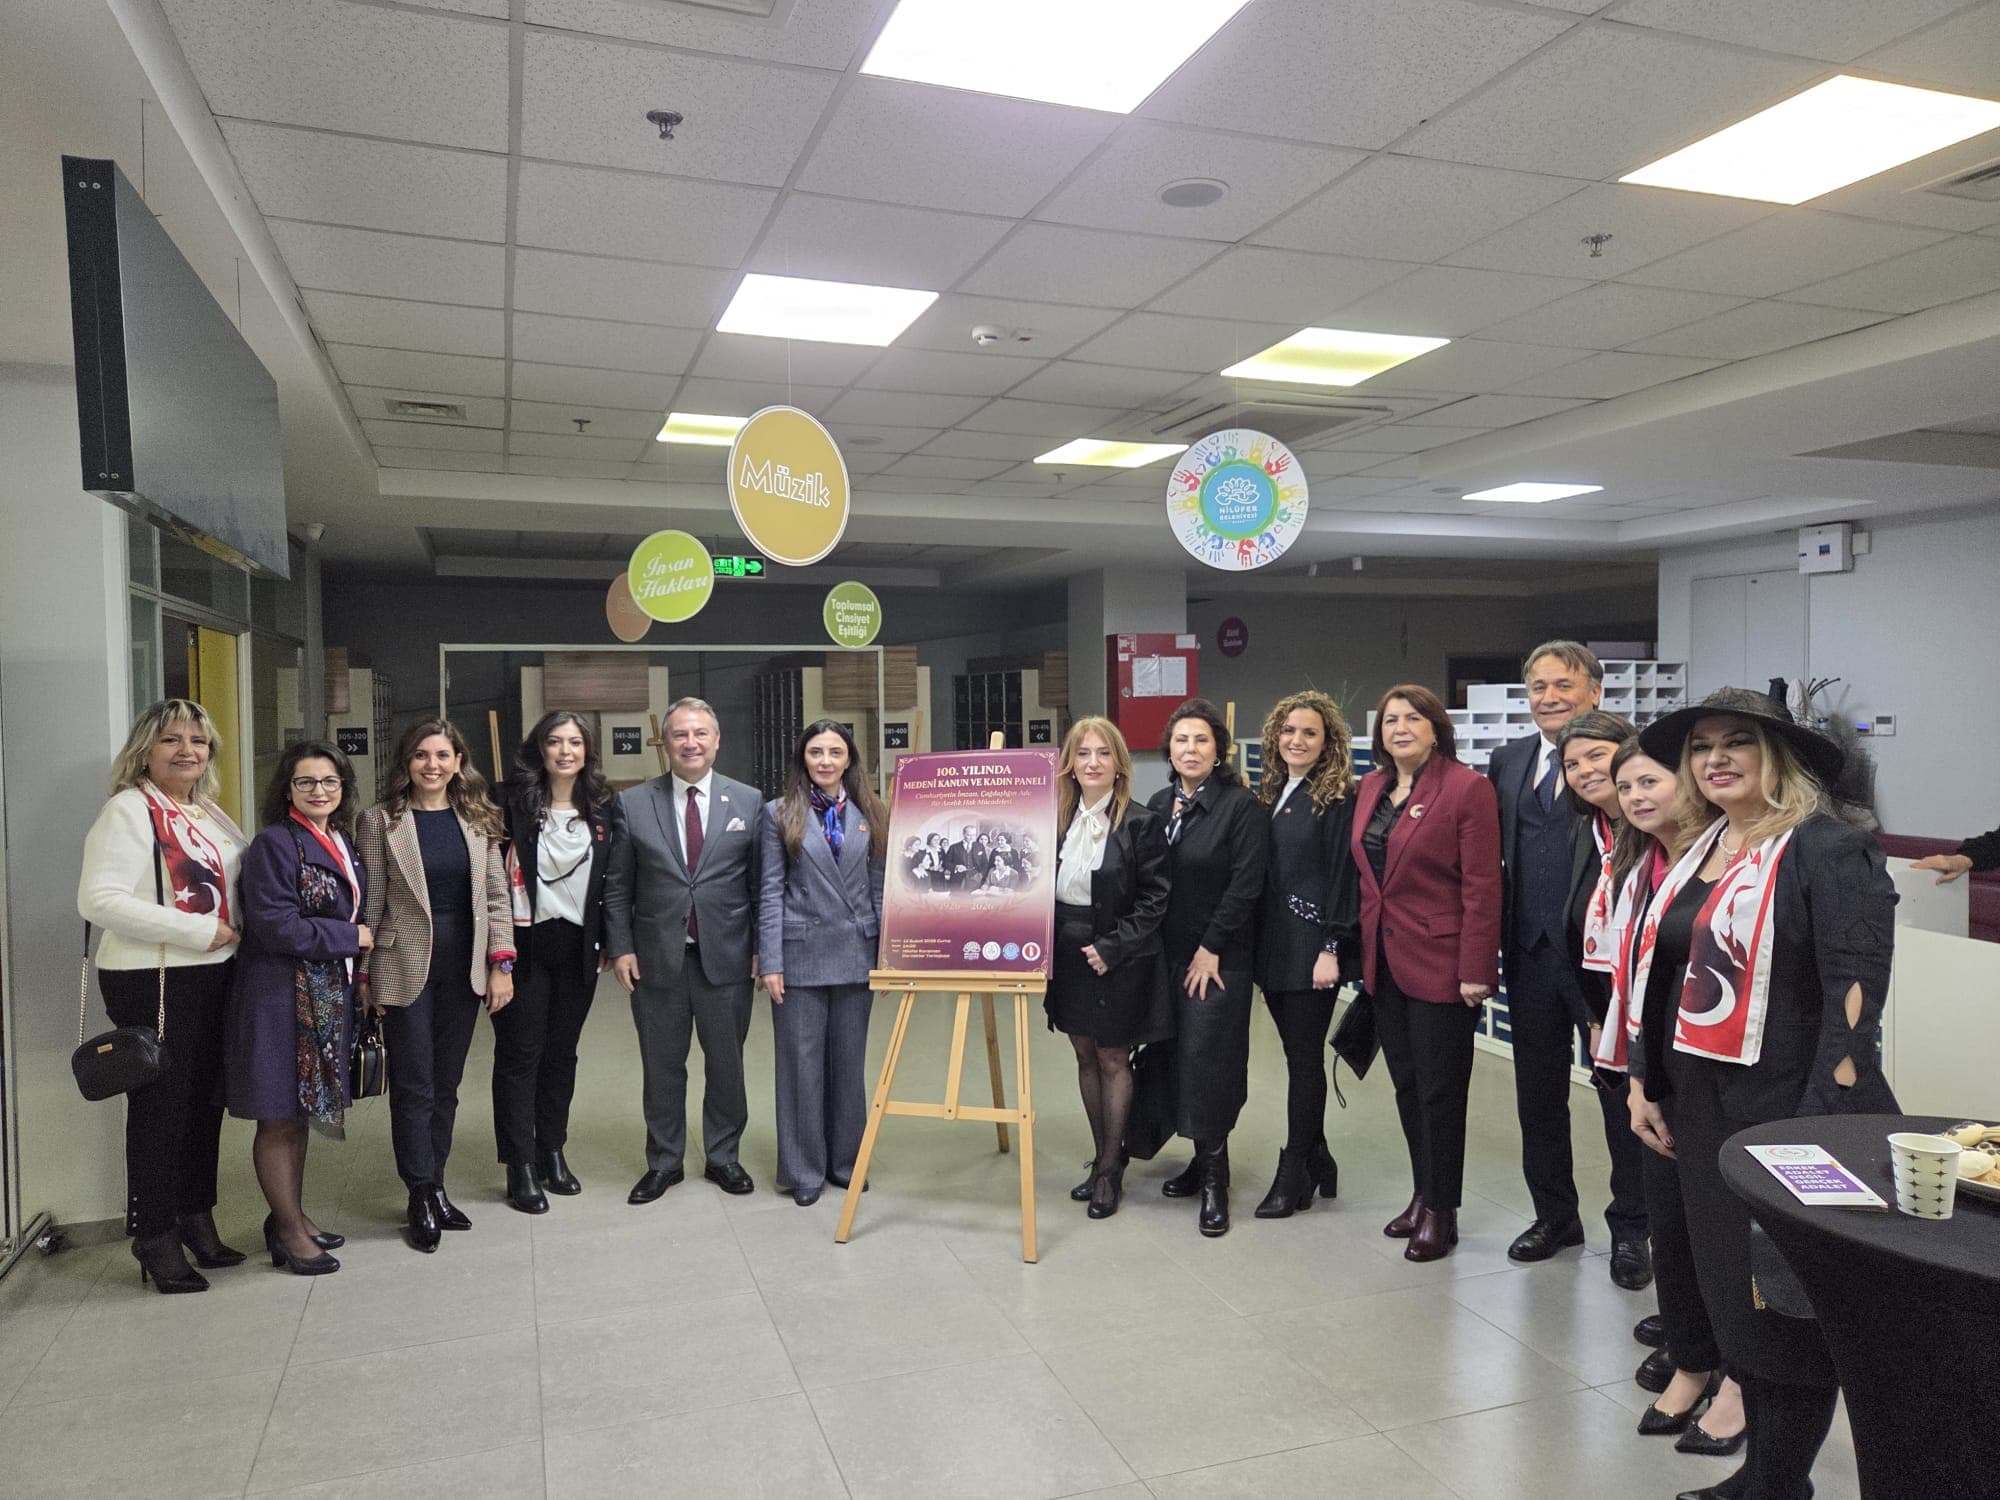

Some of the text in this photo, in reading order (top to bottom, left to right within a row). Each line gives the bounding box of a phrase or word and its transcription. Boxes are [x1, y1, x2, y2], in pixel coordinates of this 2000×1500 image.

[740, 453, 831, 508] Müzik
[1219, 505, 1257, 514] NİLÜFER
[642, 552, 695, 578] İnsan
[636, 575, 709, 601] Hakları
[831, 598, 875, 613] Toplumsal
[835, 611, 870, 625] Cinsiyet
[838, 624, 867, 639] Eşitliği
[936, 764, 1012, 777] 100. YILINDA
[903, 775, 1046, 790] MEDENİ KANUN VE KADIN PANELİ
